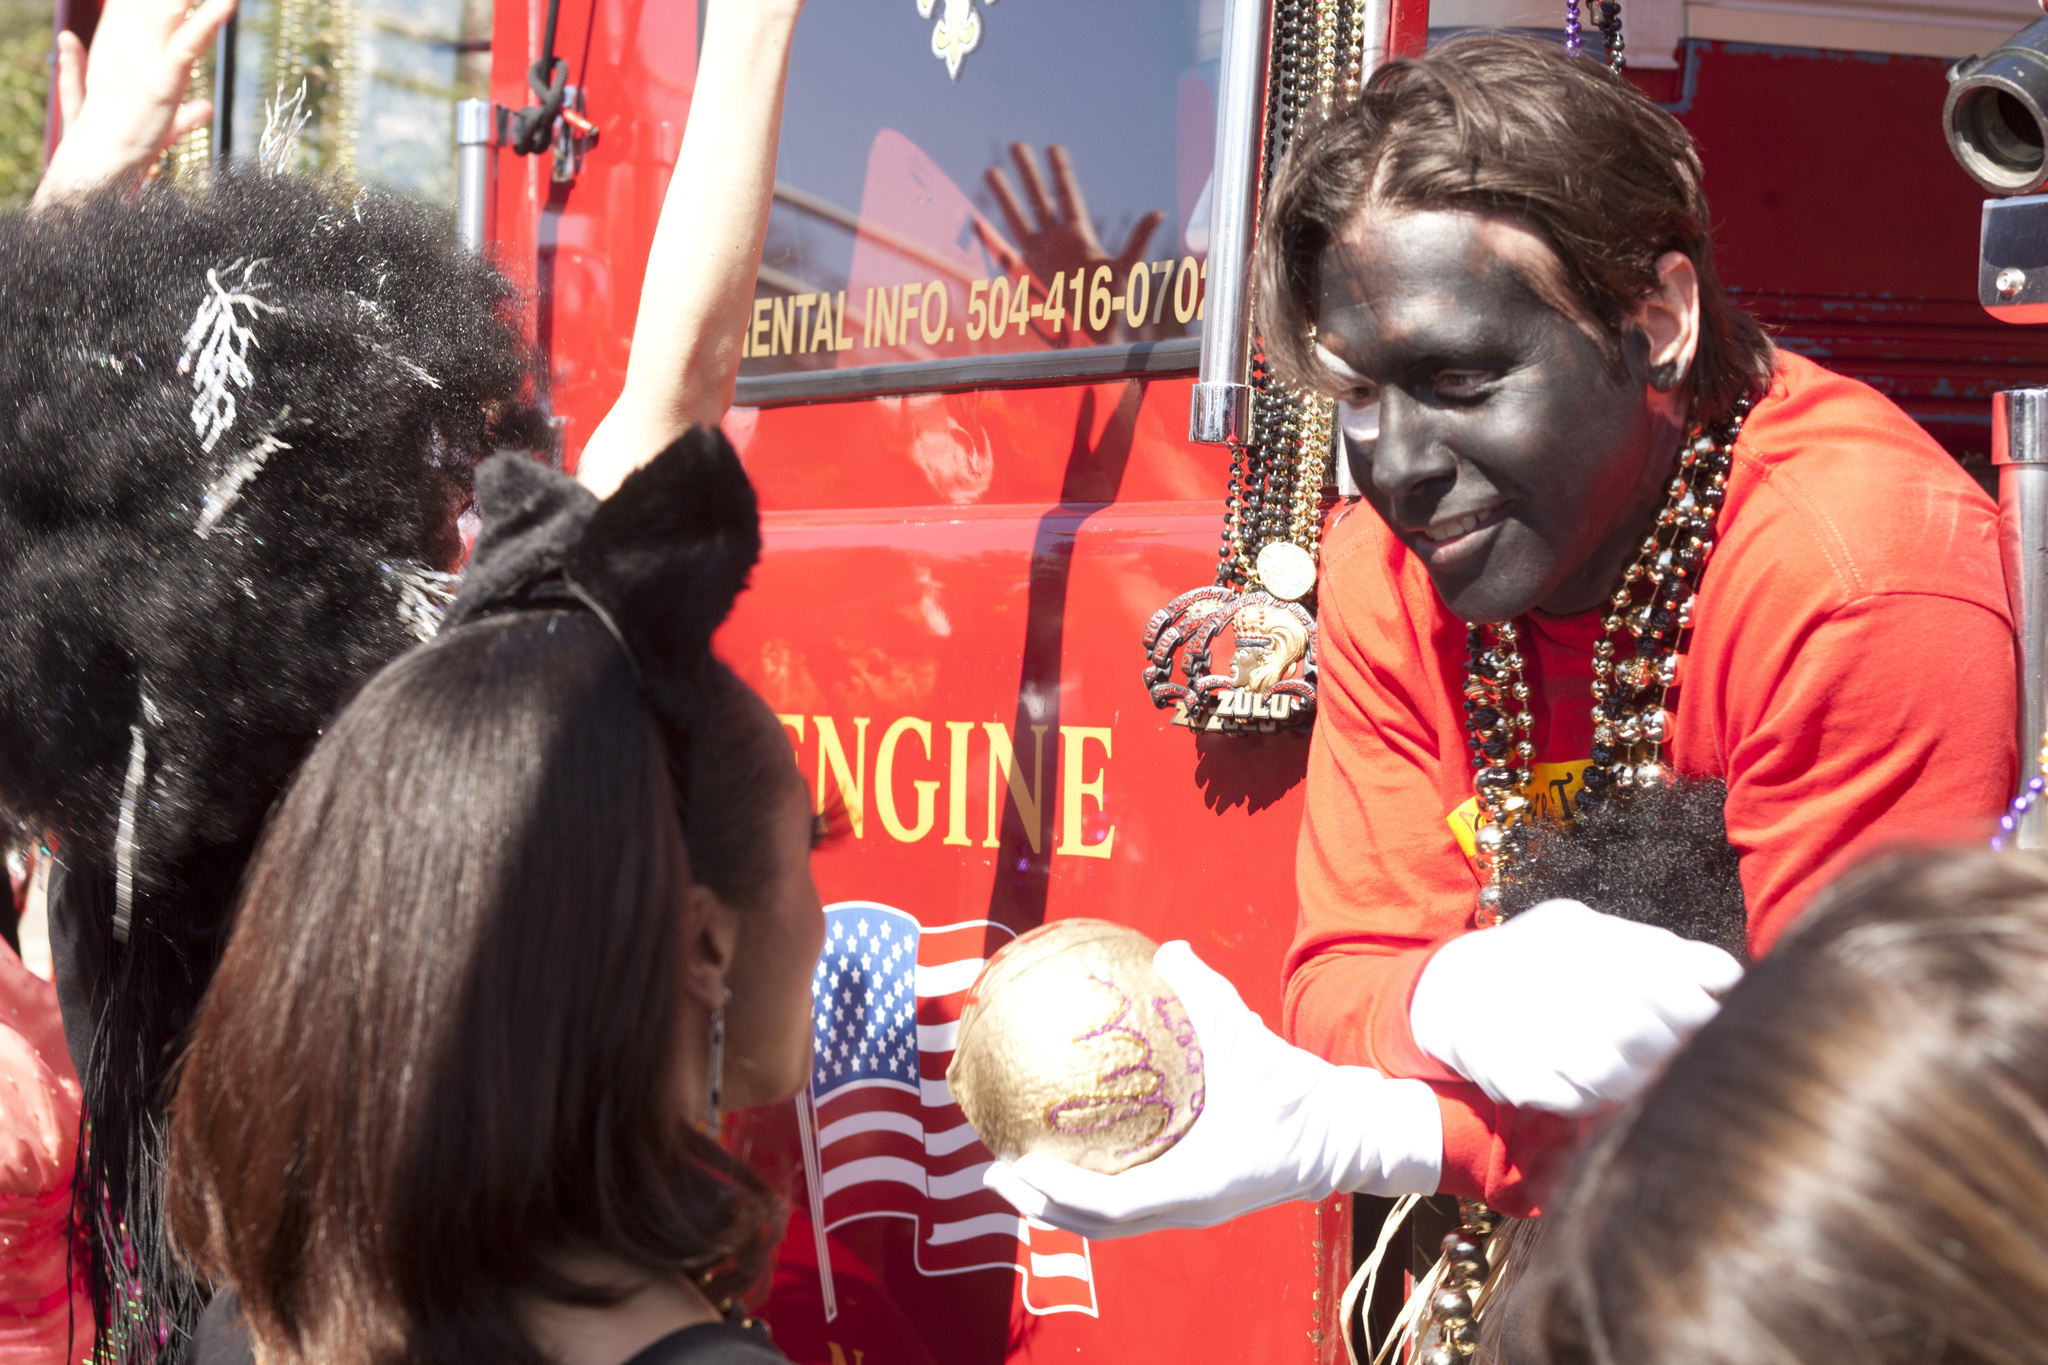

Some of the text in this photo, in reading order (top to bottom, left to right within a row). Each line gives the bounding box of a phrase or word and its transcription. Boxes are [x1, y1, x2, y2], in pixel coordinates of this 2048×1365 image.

[863, 280, 954, 349] INFO.
[1144, 611, 1166, 644] 1909
[1192, 621, 1212, 654] 1909
[1154, 630, 1177, 662] 1909
[1215, 690, 1290, 719] ZULU
